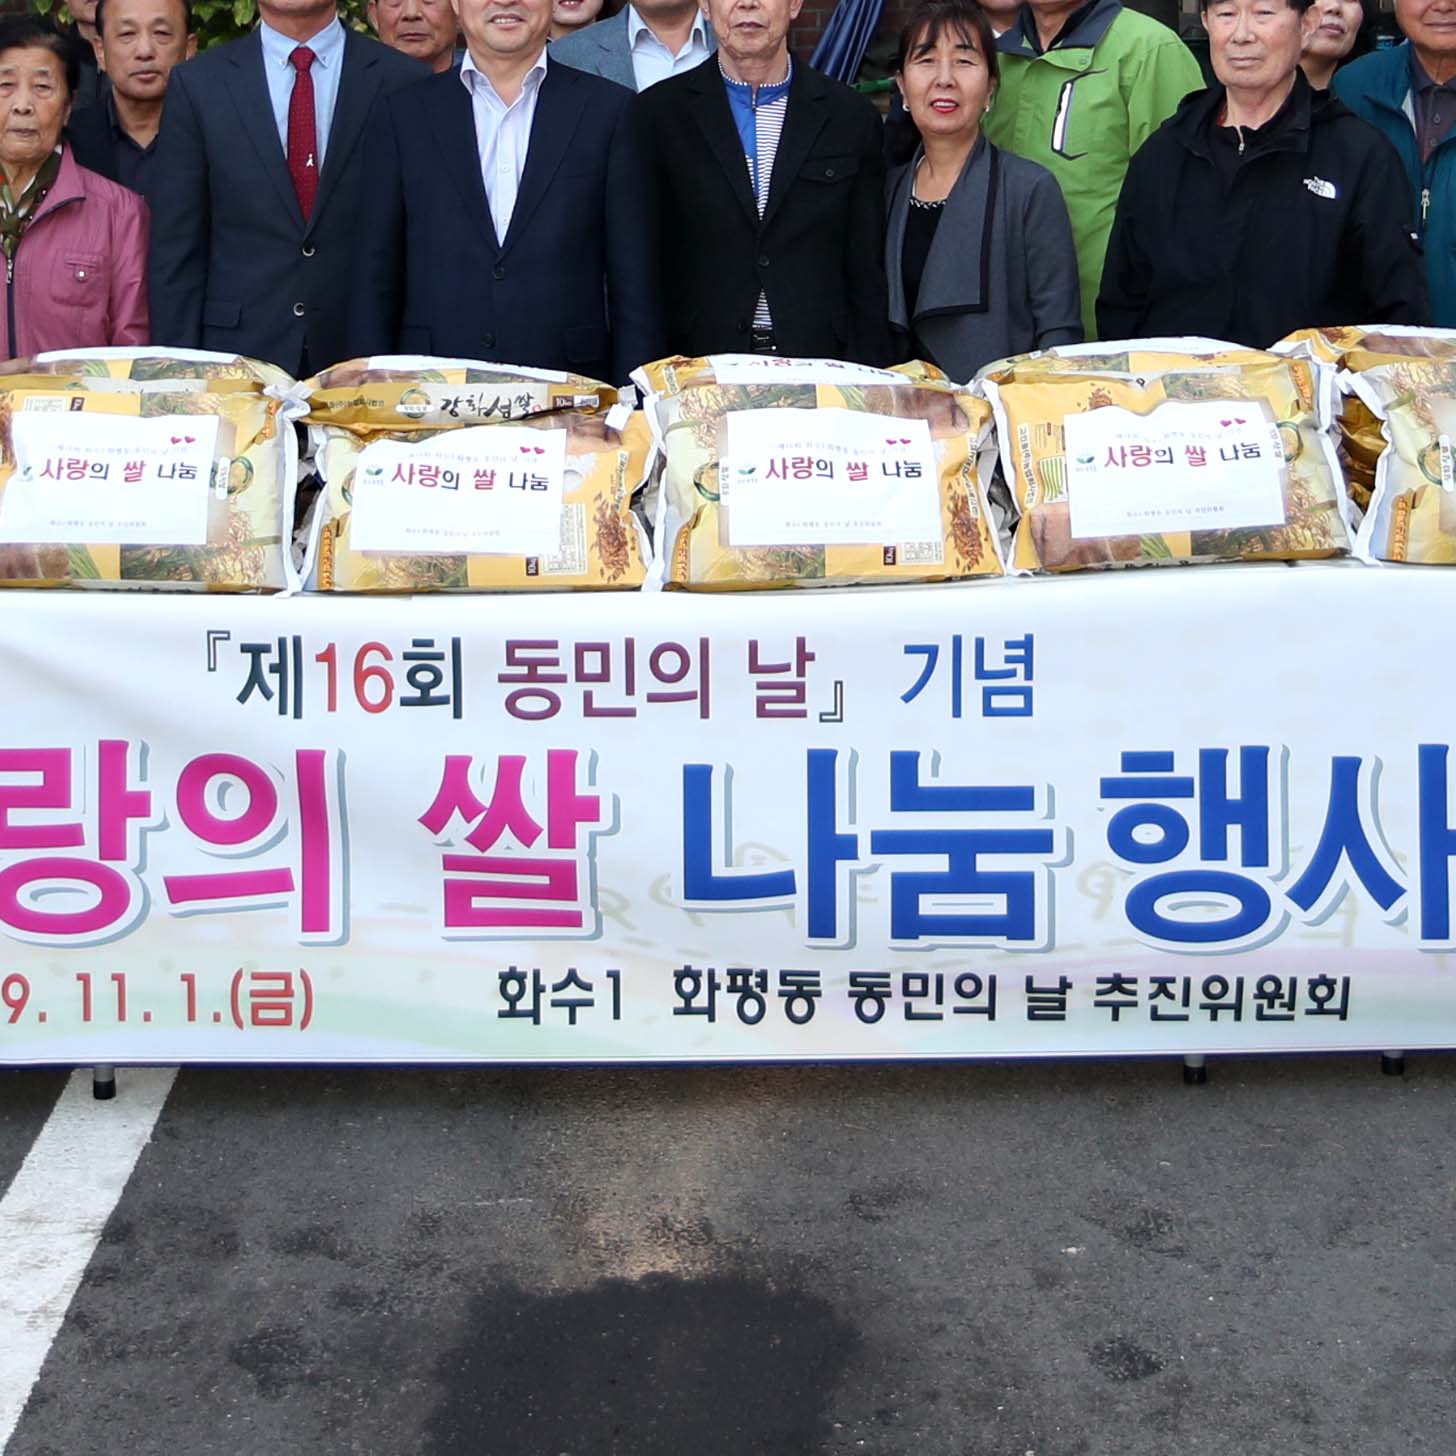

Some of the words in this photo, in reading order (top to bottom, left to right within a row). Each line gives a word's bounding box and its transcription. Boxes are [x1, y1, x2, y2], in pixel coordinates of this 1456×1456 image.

[40, 457, 110, 482] 사랑의
[123, 458, 147, 483] 쌀
[157, 461, 199, 481] 나눔
[765, 456, 835, 481] 사랑의
[846, 458, 870, 481] 쌀
[882, 458, 923, 479] 나눔
[1104, 444, 1174, 469] 사랑의
[1184, 444, 1208, 468] 쌀
[1219, 441, 1263, 463] 나눔
[391, 462, 460, 491] 사랑의
[473, 468, 497, 491] 쌀
[509, 470, 550, 492] 나눔
[205, 629, 462, 720] 『제16회
[497, 635, 711, 721] 동민의
[747, 635, 844, 723] 날』
[899, 632, 1035, 719] 기념
[417, 747, 610, 934] 쌀
[75, 972, 152, 1024] 11.
[496, 965, 621, 1025] 화수1
[671, 964, 823, 1025] 화평동
[847, 969, 998, 1024] 동민의
[1024, 974, 1074, 1022] 날
[1092, 972, 1353, 1023] 추진위원회
